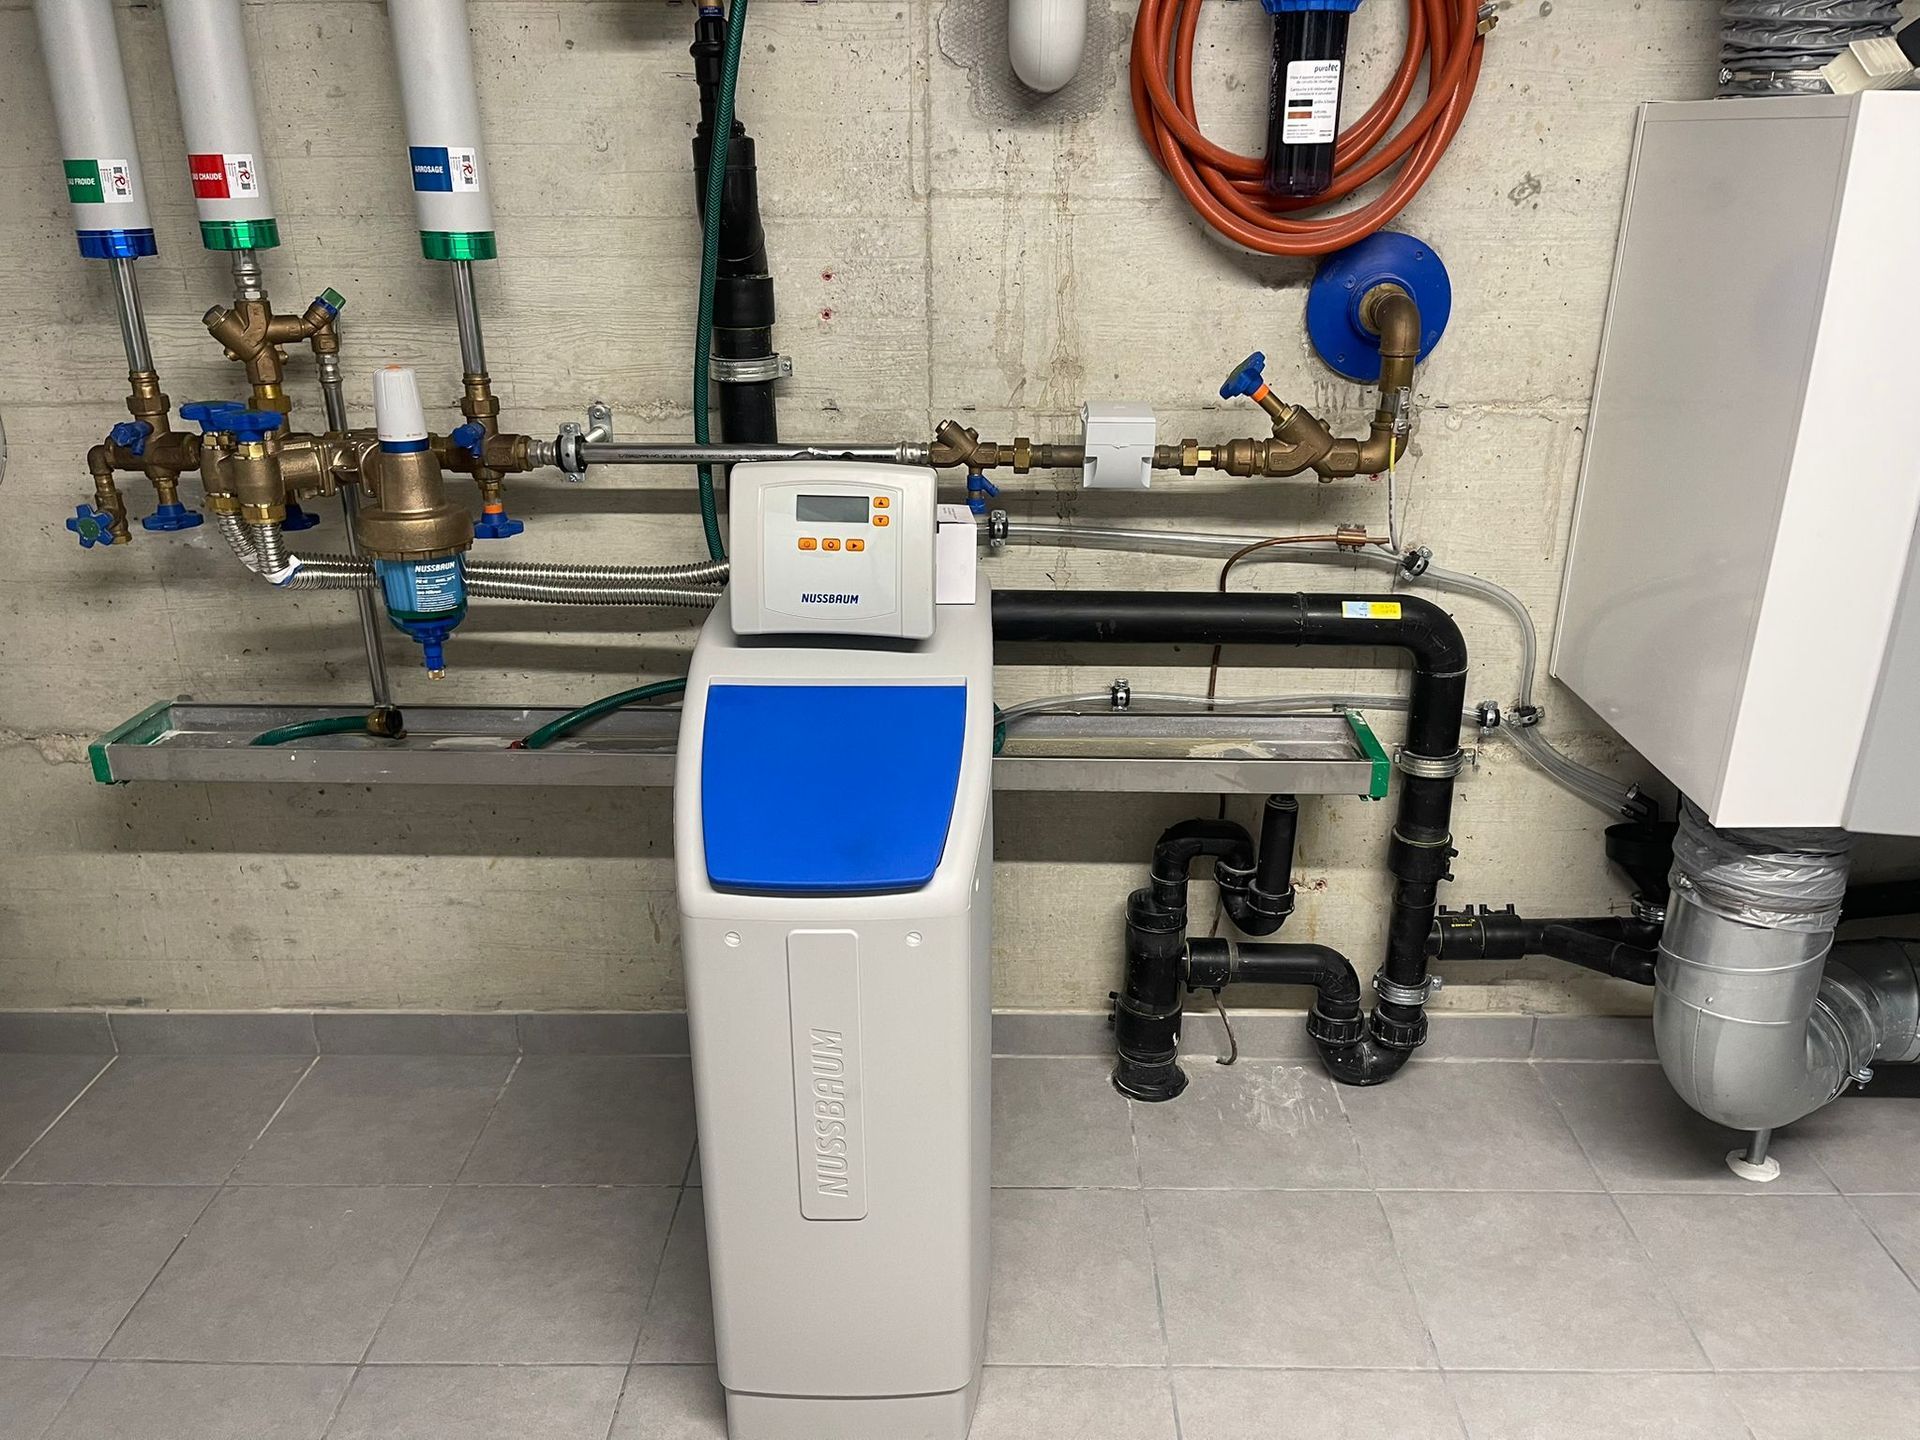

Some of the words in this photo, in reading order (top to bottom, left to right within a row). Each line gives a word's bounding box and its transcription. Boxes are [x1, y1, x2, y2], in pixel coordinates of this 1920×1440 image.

[199, 172, 223, 181] CHAUDE
[801, 593, 859, 605] NUSSBAUM
[810, 1028, 849, 1198] NUSSBAUM
